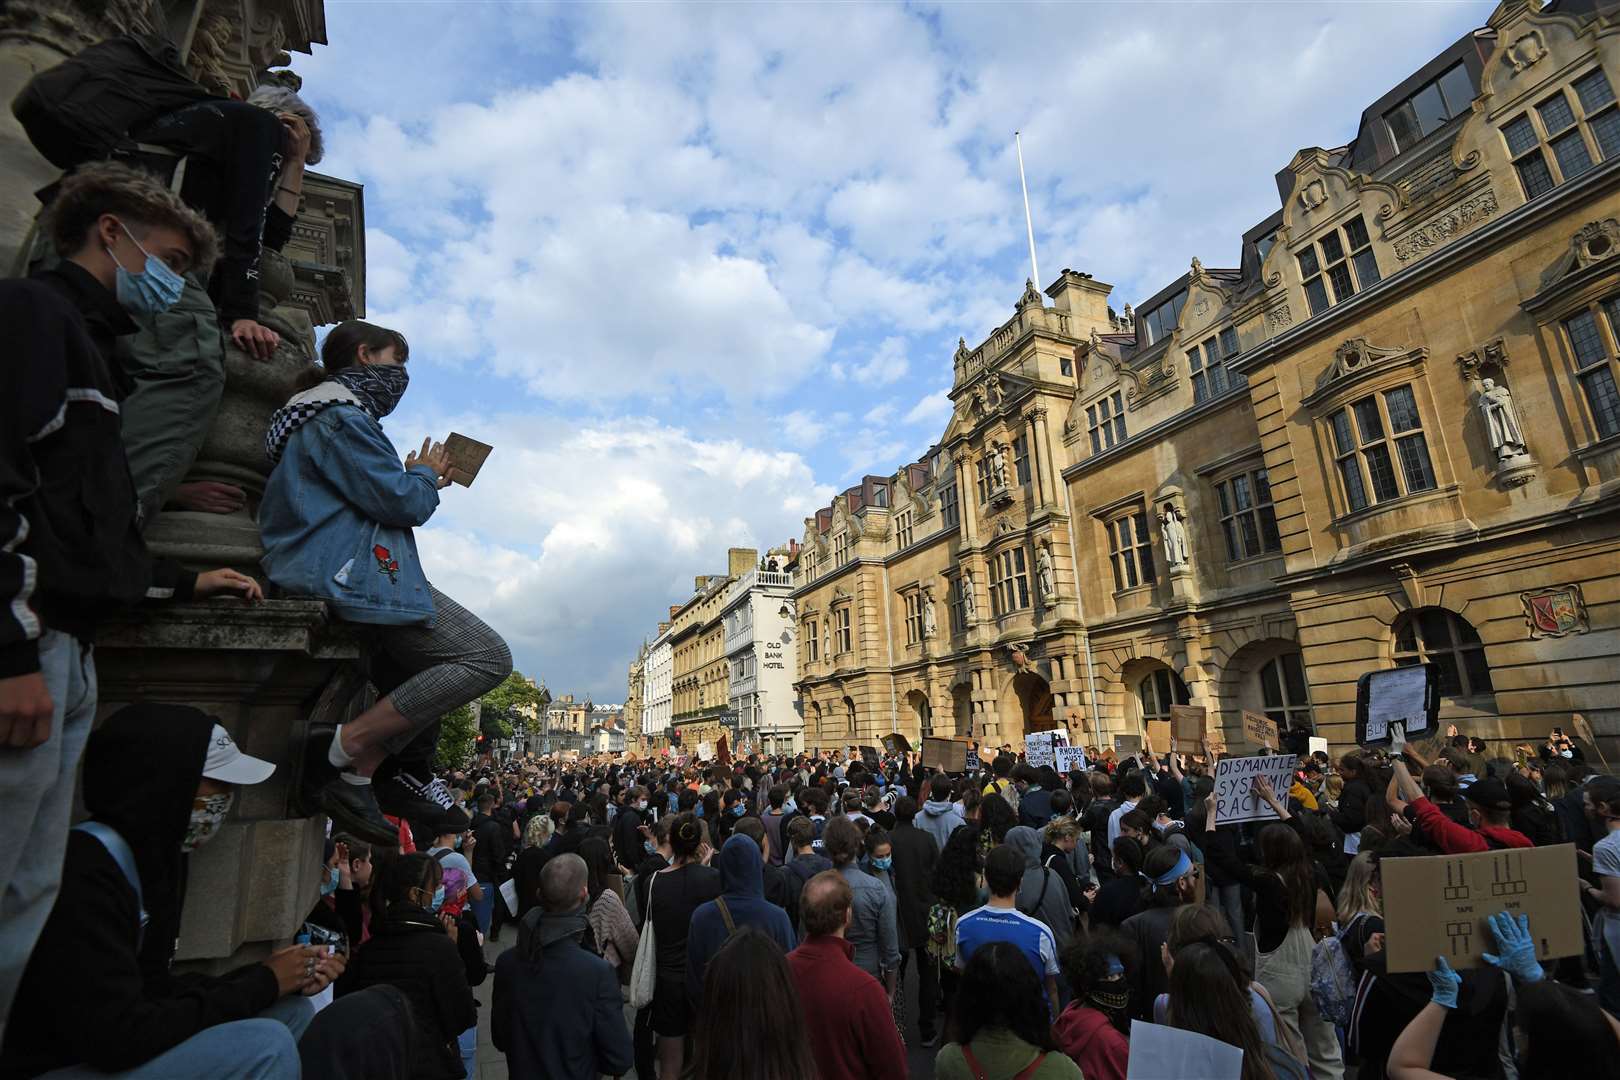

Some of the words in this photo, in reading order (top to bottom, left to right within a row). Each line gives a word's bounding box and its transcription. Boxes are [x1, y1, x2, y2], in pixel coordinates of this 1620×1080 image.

[1367, 721, 1387, 737] BLM
[1059, 747, 1083, 755] RHODES
[1220, 756, 1296, 776] DISMANTLE
[1218, 773, 1292, 796] SYSTMIC
